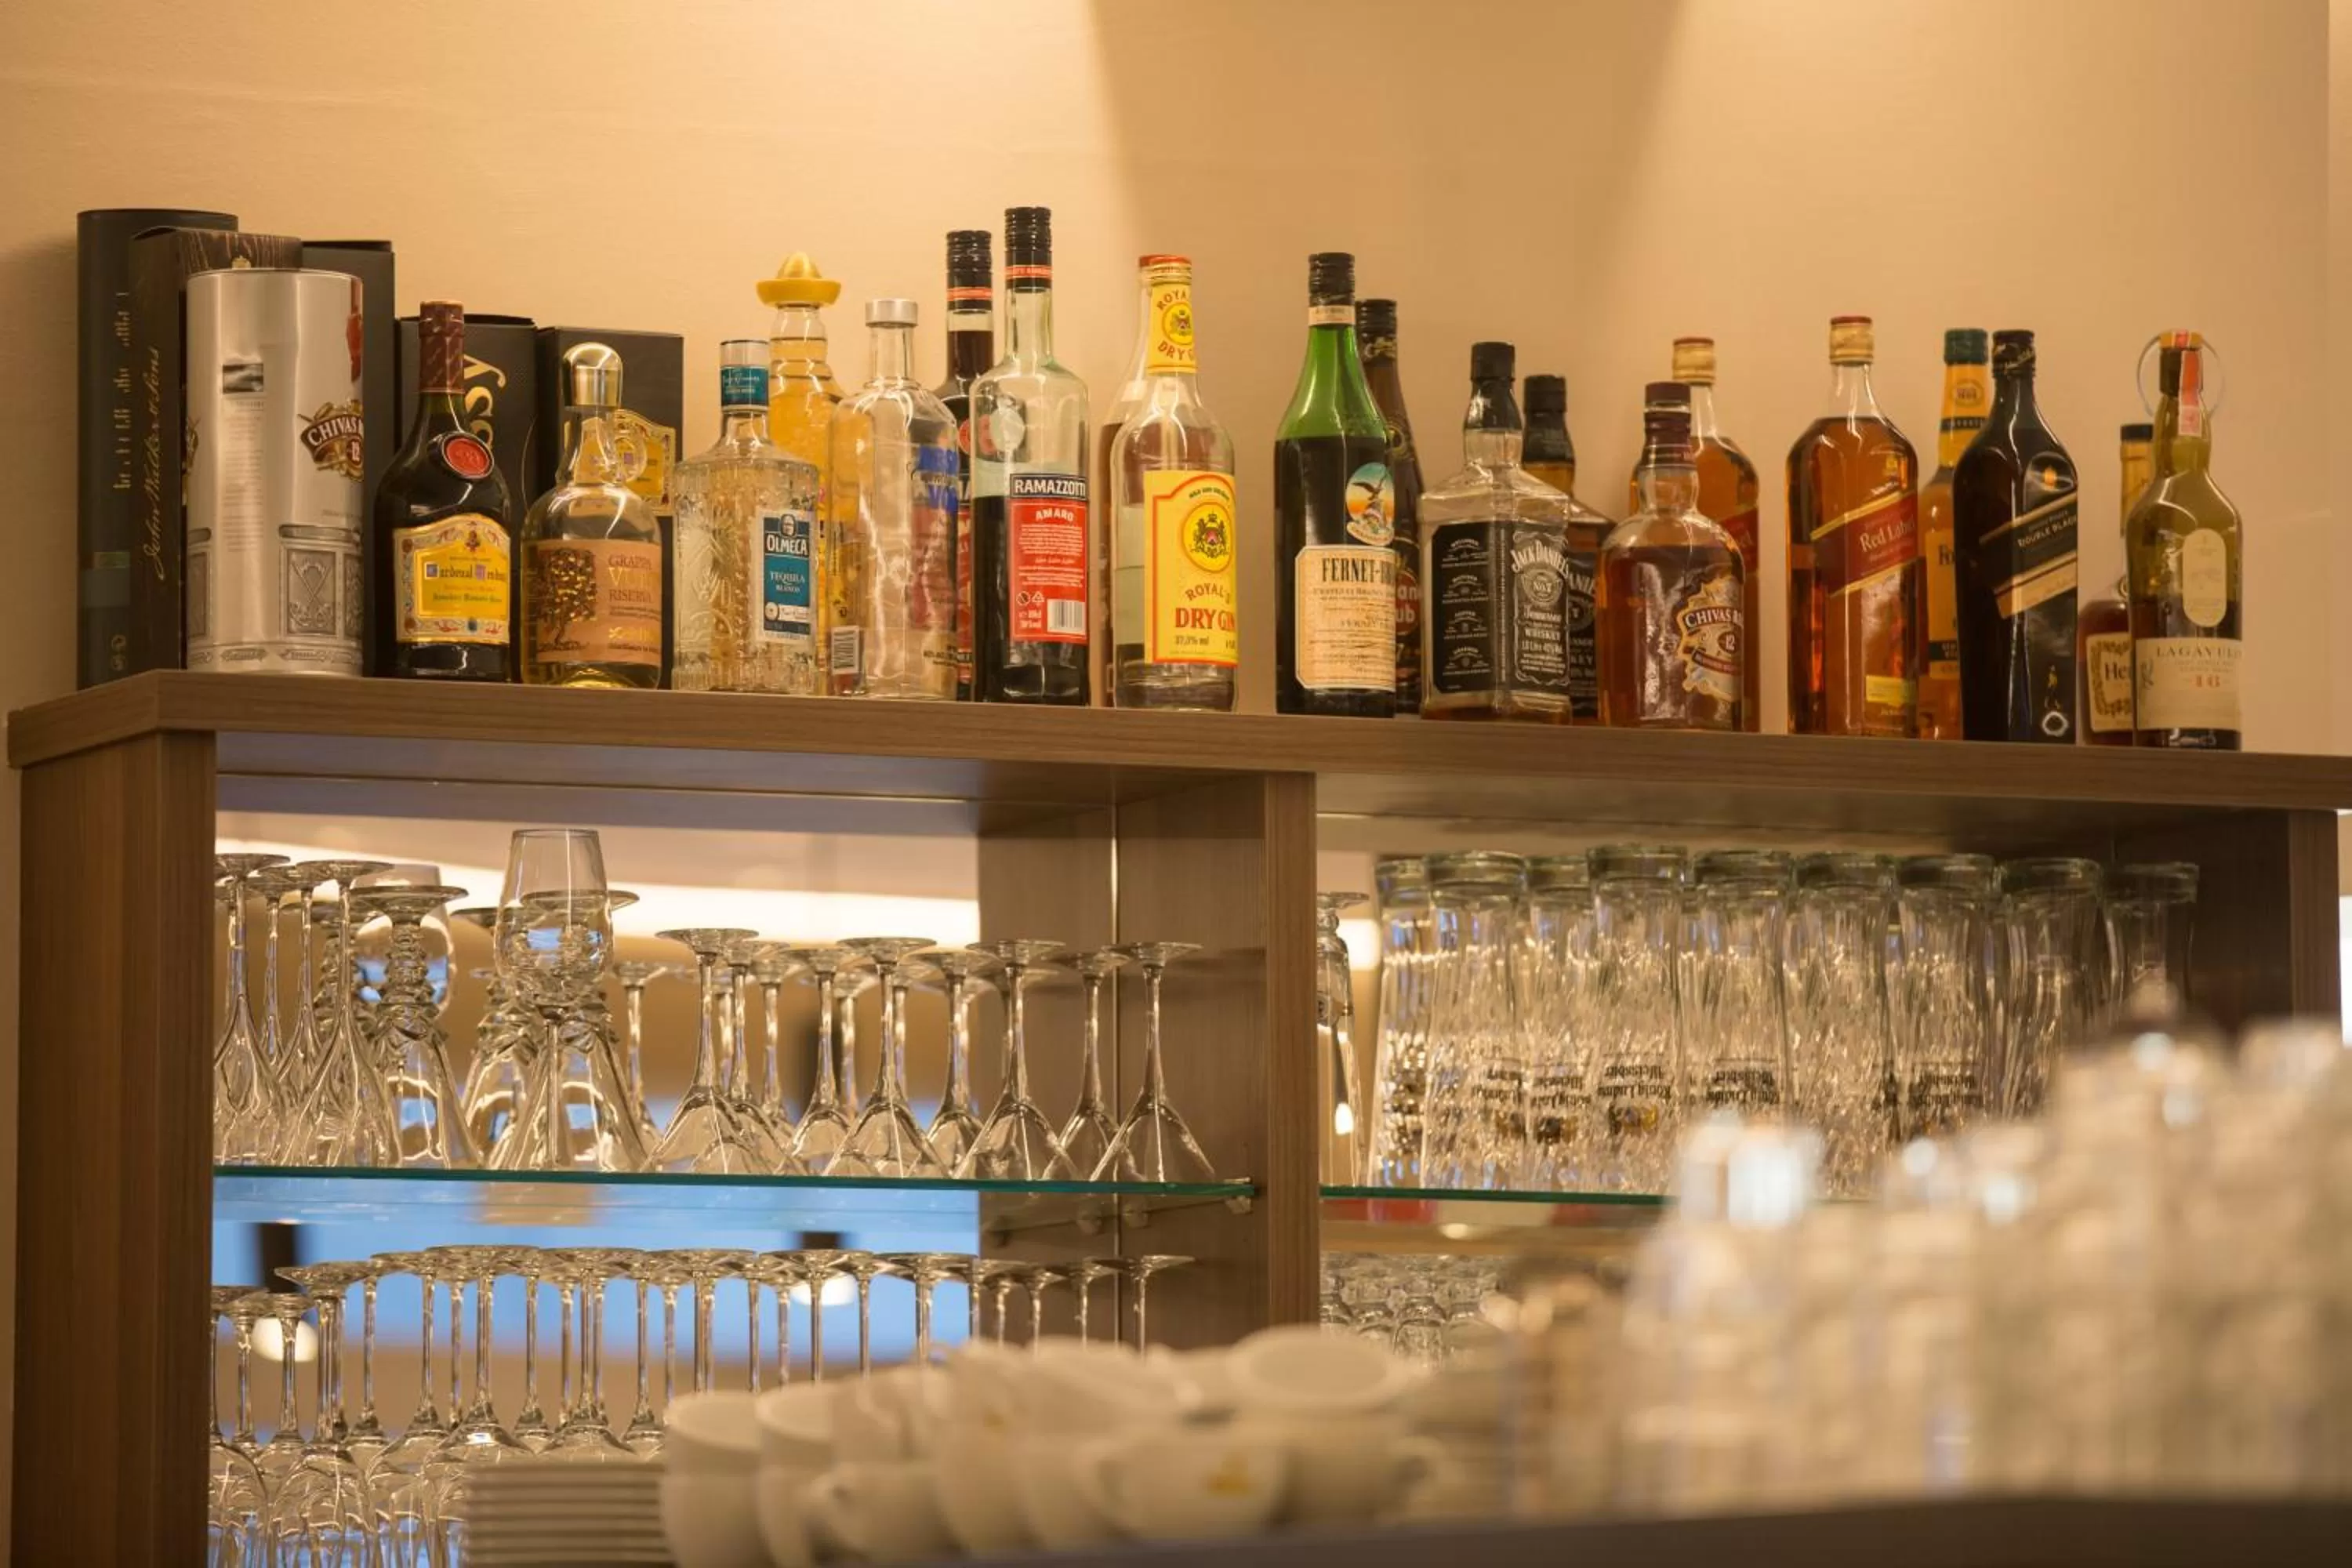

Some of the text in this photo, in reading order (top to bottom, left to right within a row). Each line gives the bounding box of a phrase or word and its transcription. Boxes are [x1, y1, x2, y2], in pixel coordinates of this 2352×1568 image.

[1157, 339, 1185, 361] DRY
[307, 416, 358, 446] CHIVAS
[1035, 507, 1074, 522] AMARO
[766, 534, 808, 557] OLMECA
[1859, 527, 1887, 553] Red
[1510, 544, 1535, 574] JACK
[769, 571, 806, 584] TEQUILA
[1174, 607, 1217, 630] DRY
[1685, 608, 1731, 628] CHIVAS
[1725, 633, 1736, 651] 12
